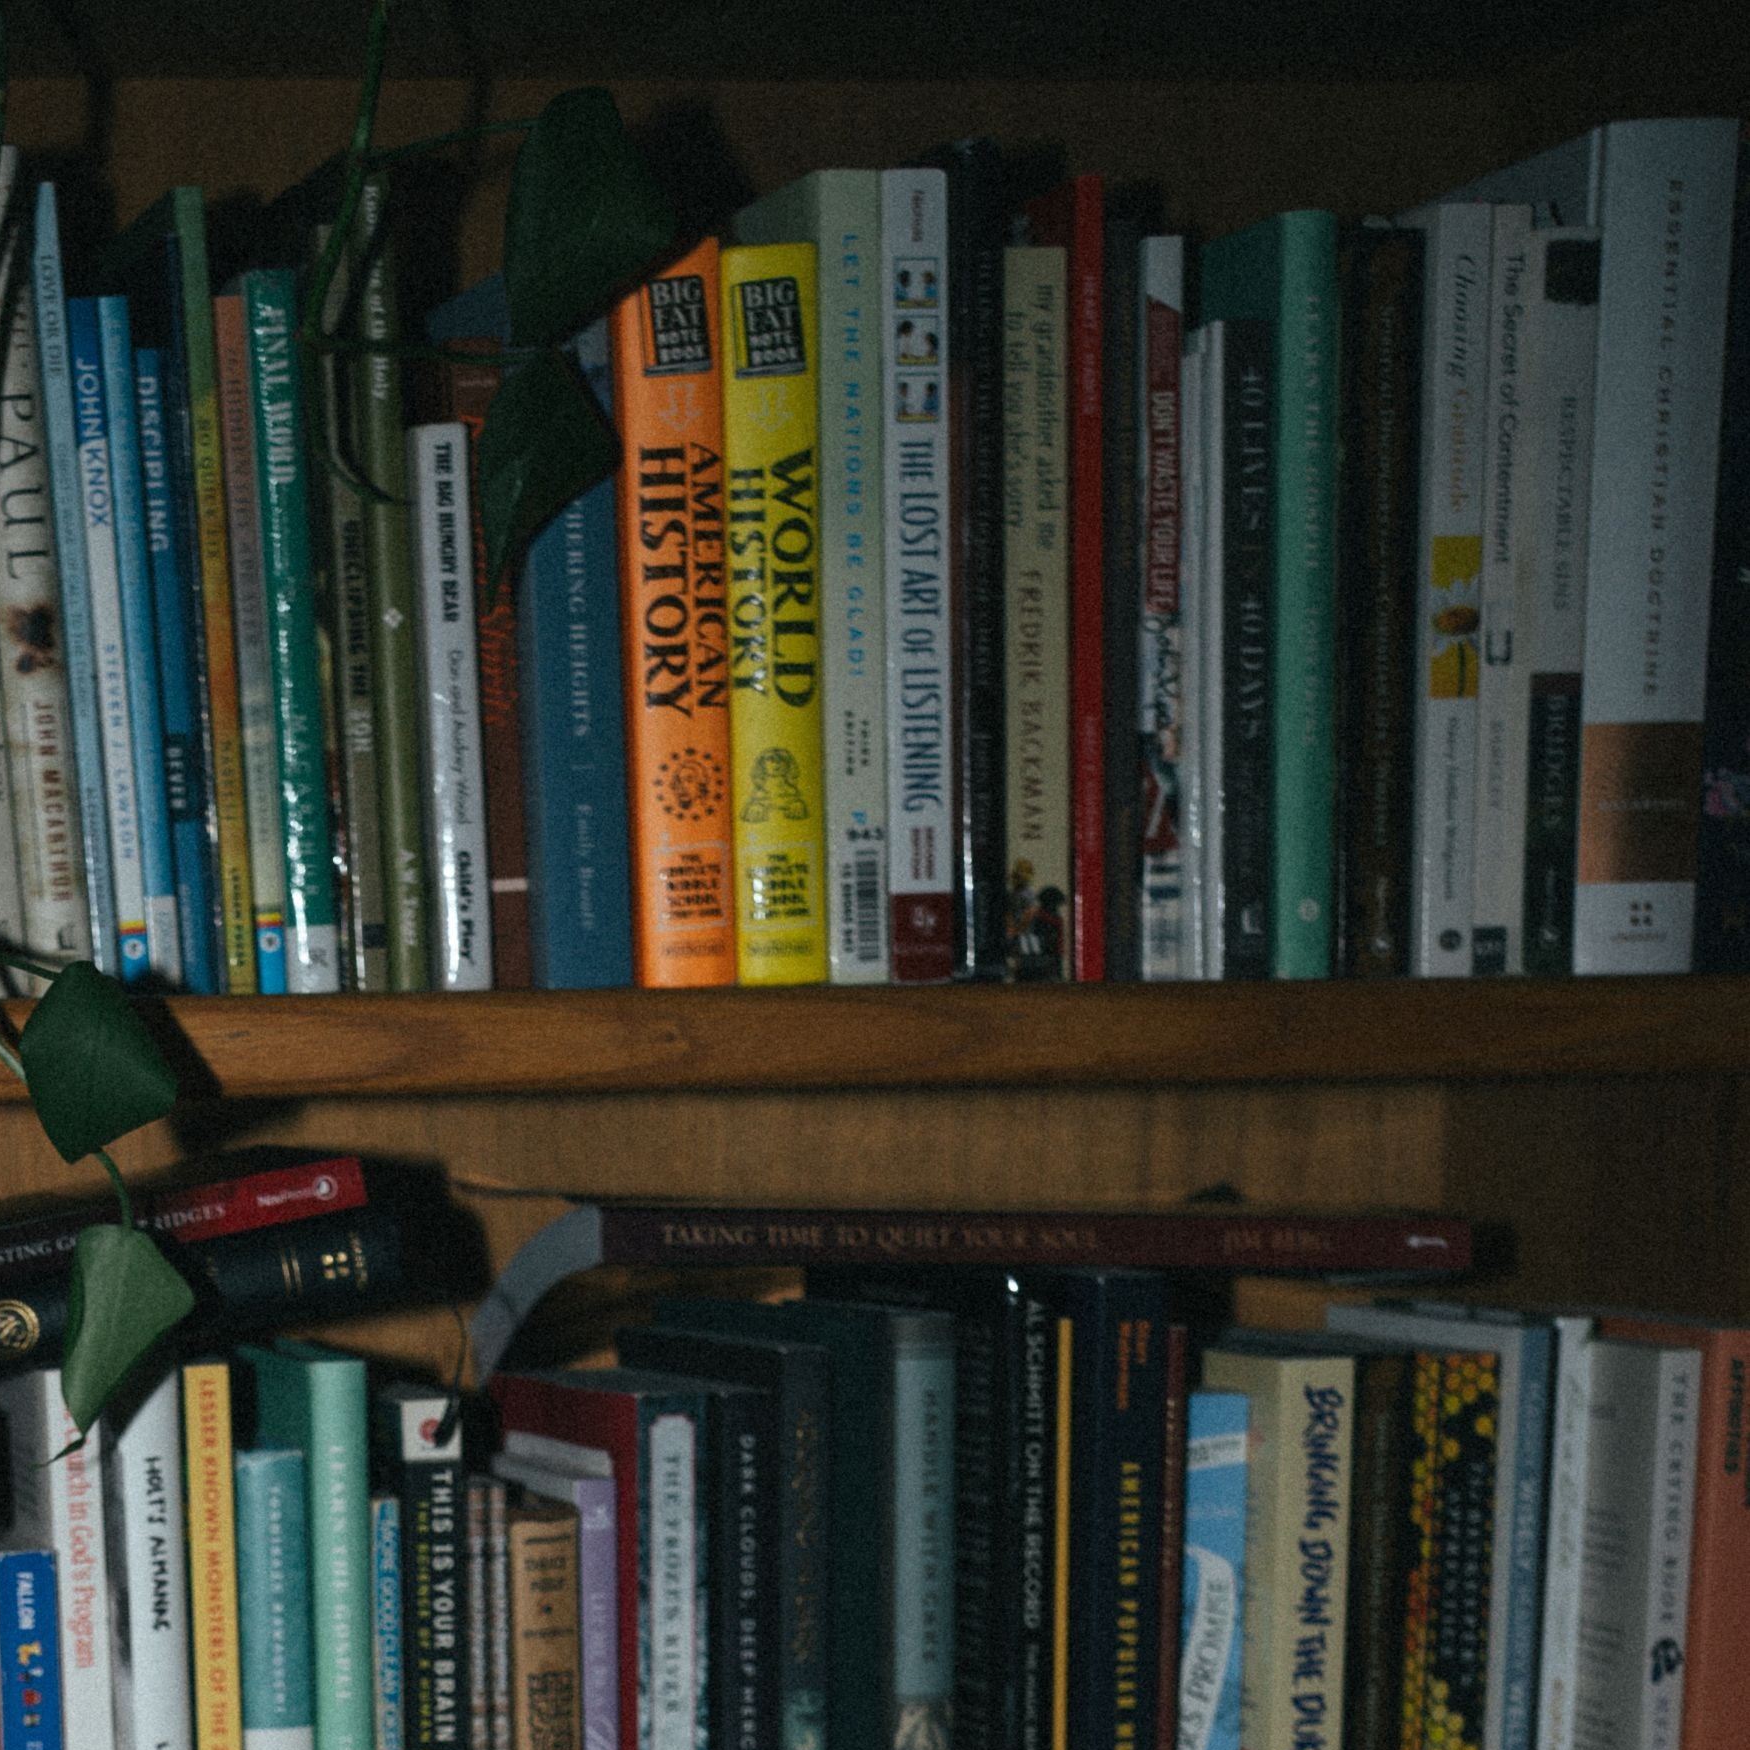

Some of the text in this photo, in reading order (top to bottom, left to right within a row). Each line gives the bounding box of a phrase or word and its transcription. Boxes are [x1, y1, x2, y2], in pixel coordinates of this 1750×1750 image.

[41, 254, 64, 374] LOVE OR DIE
[1004, 312, 1024, 331] to
[1450, 254, 1476, 380] Choosing
[1649, 178, 1684, 530] ESSENTIAL CHRISTIAN
[74, 358, 104, 440] JOHN
[842, 232, 865, 676] LET THE NATIONS BE GLAD!
[1030, 284, 1060, 550] my grandmother asked me
[1495, 254, 1524, 564] The Secret of Contentment
[83, 446, 110, 528] KNOX
[1152, 390, 1176, 562] DON'T WASTE YOUR
[1304, 403, 1320, 571] THE GOSPEL
[138, 376, 186, 810] DISCIPLING DEVER
[638, 446, 692, 718] HISTORY
[690, 440, 728, 708] AMERICAN
[728, 468, 767, 697] HISTORY
[771, 449, 817, 708] WORLD
[899, 440, 942, 812] THE LOST ART OF LISTENING
[105, 644, 122, 728] STEVEN
[434, 442, 473, 912] THE BIG HUNGRY BEAR Audrey Child's
[1018, 570, 1043, 841] FREDRIK BACKMAN
[1241, 646, 1264, 740] DAYS
[664, 1224, 758, 1247] TAKING
[198, 1378, 216, 1449] LESSER
[738, 1434, 756, 1494] DARK
[1023, 1300, 1044, 1630] AL SCHMITT ON THE RECORD
[202, 1455, 222, 1544] KNOWN
[431, 1469, 454, 1532] THIS
[1118, 1460, 1142, 1587] AMERICAN
[16, 1572, 35, 1631] FALLON
[150, 1536, 172, 1632] ALMANAC
[206, 1551, 226, 1660] MONSTERS
[432, 1544, 453, 1572] IS
[432, 1580, 454, 1649] YOUR
[663, 1454, 682, 1715] THE FROZEN RIVER
[330, 1544, 351, 1702] THE GOSPEL
[739, 1618, 756, 1676] DEEP
[1116, 1600, 1140, 1709] POPULAR
[209, 1668, 228, 1694] OF
[211, 1702, 231, 1738] THE
[433, 1659, 458, 1742] BRAIN
